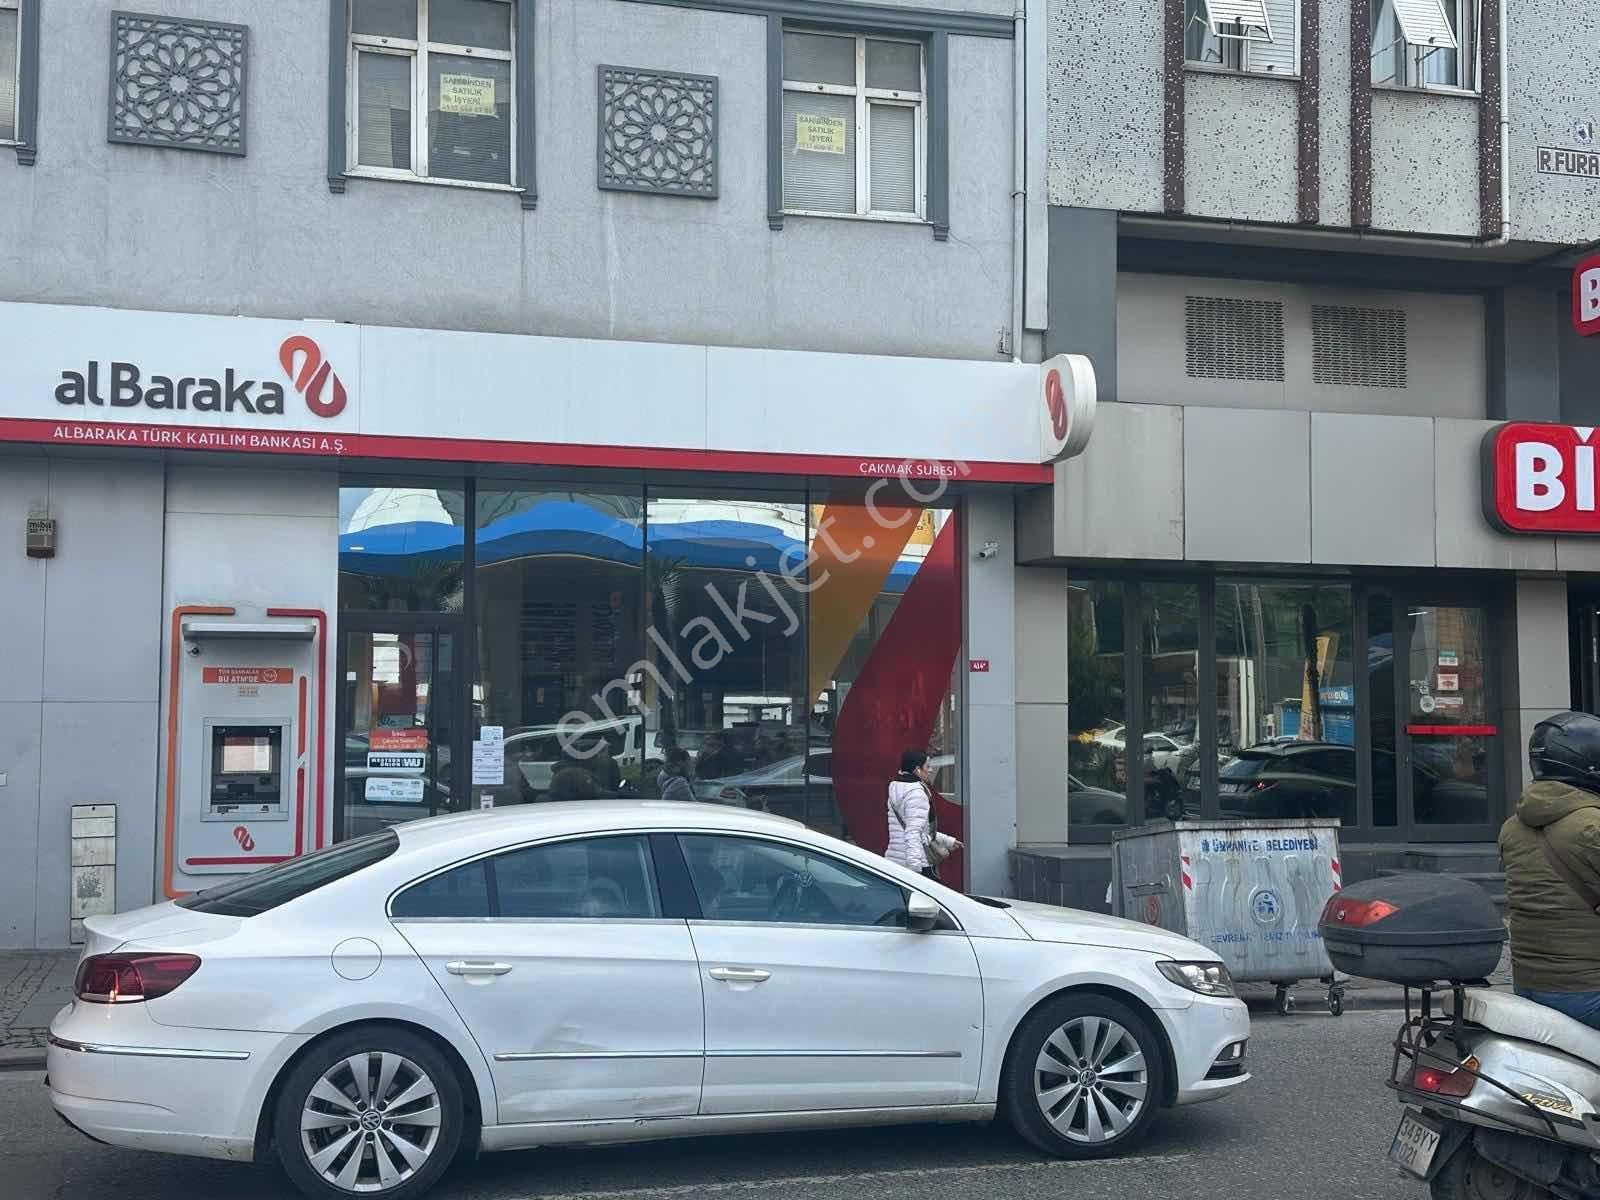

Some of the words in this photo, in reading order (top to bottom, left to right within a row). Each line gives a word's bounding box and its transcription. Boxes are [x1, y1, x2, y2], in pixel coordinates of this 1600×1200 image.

[54, 360, 284, 415] alBaraka
[53, 426, 138, 441] ALBARAKA
[142, 427, 182, 443] TÜRK
[186, 432, 246, 446] KATILIM
[249, 434, 316, 449] BANKASI
[319, 438, 348, 454] A.Ş.
[217, 675, 230, 683] BU
